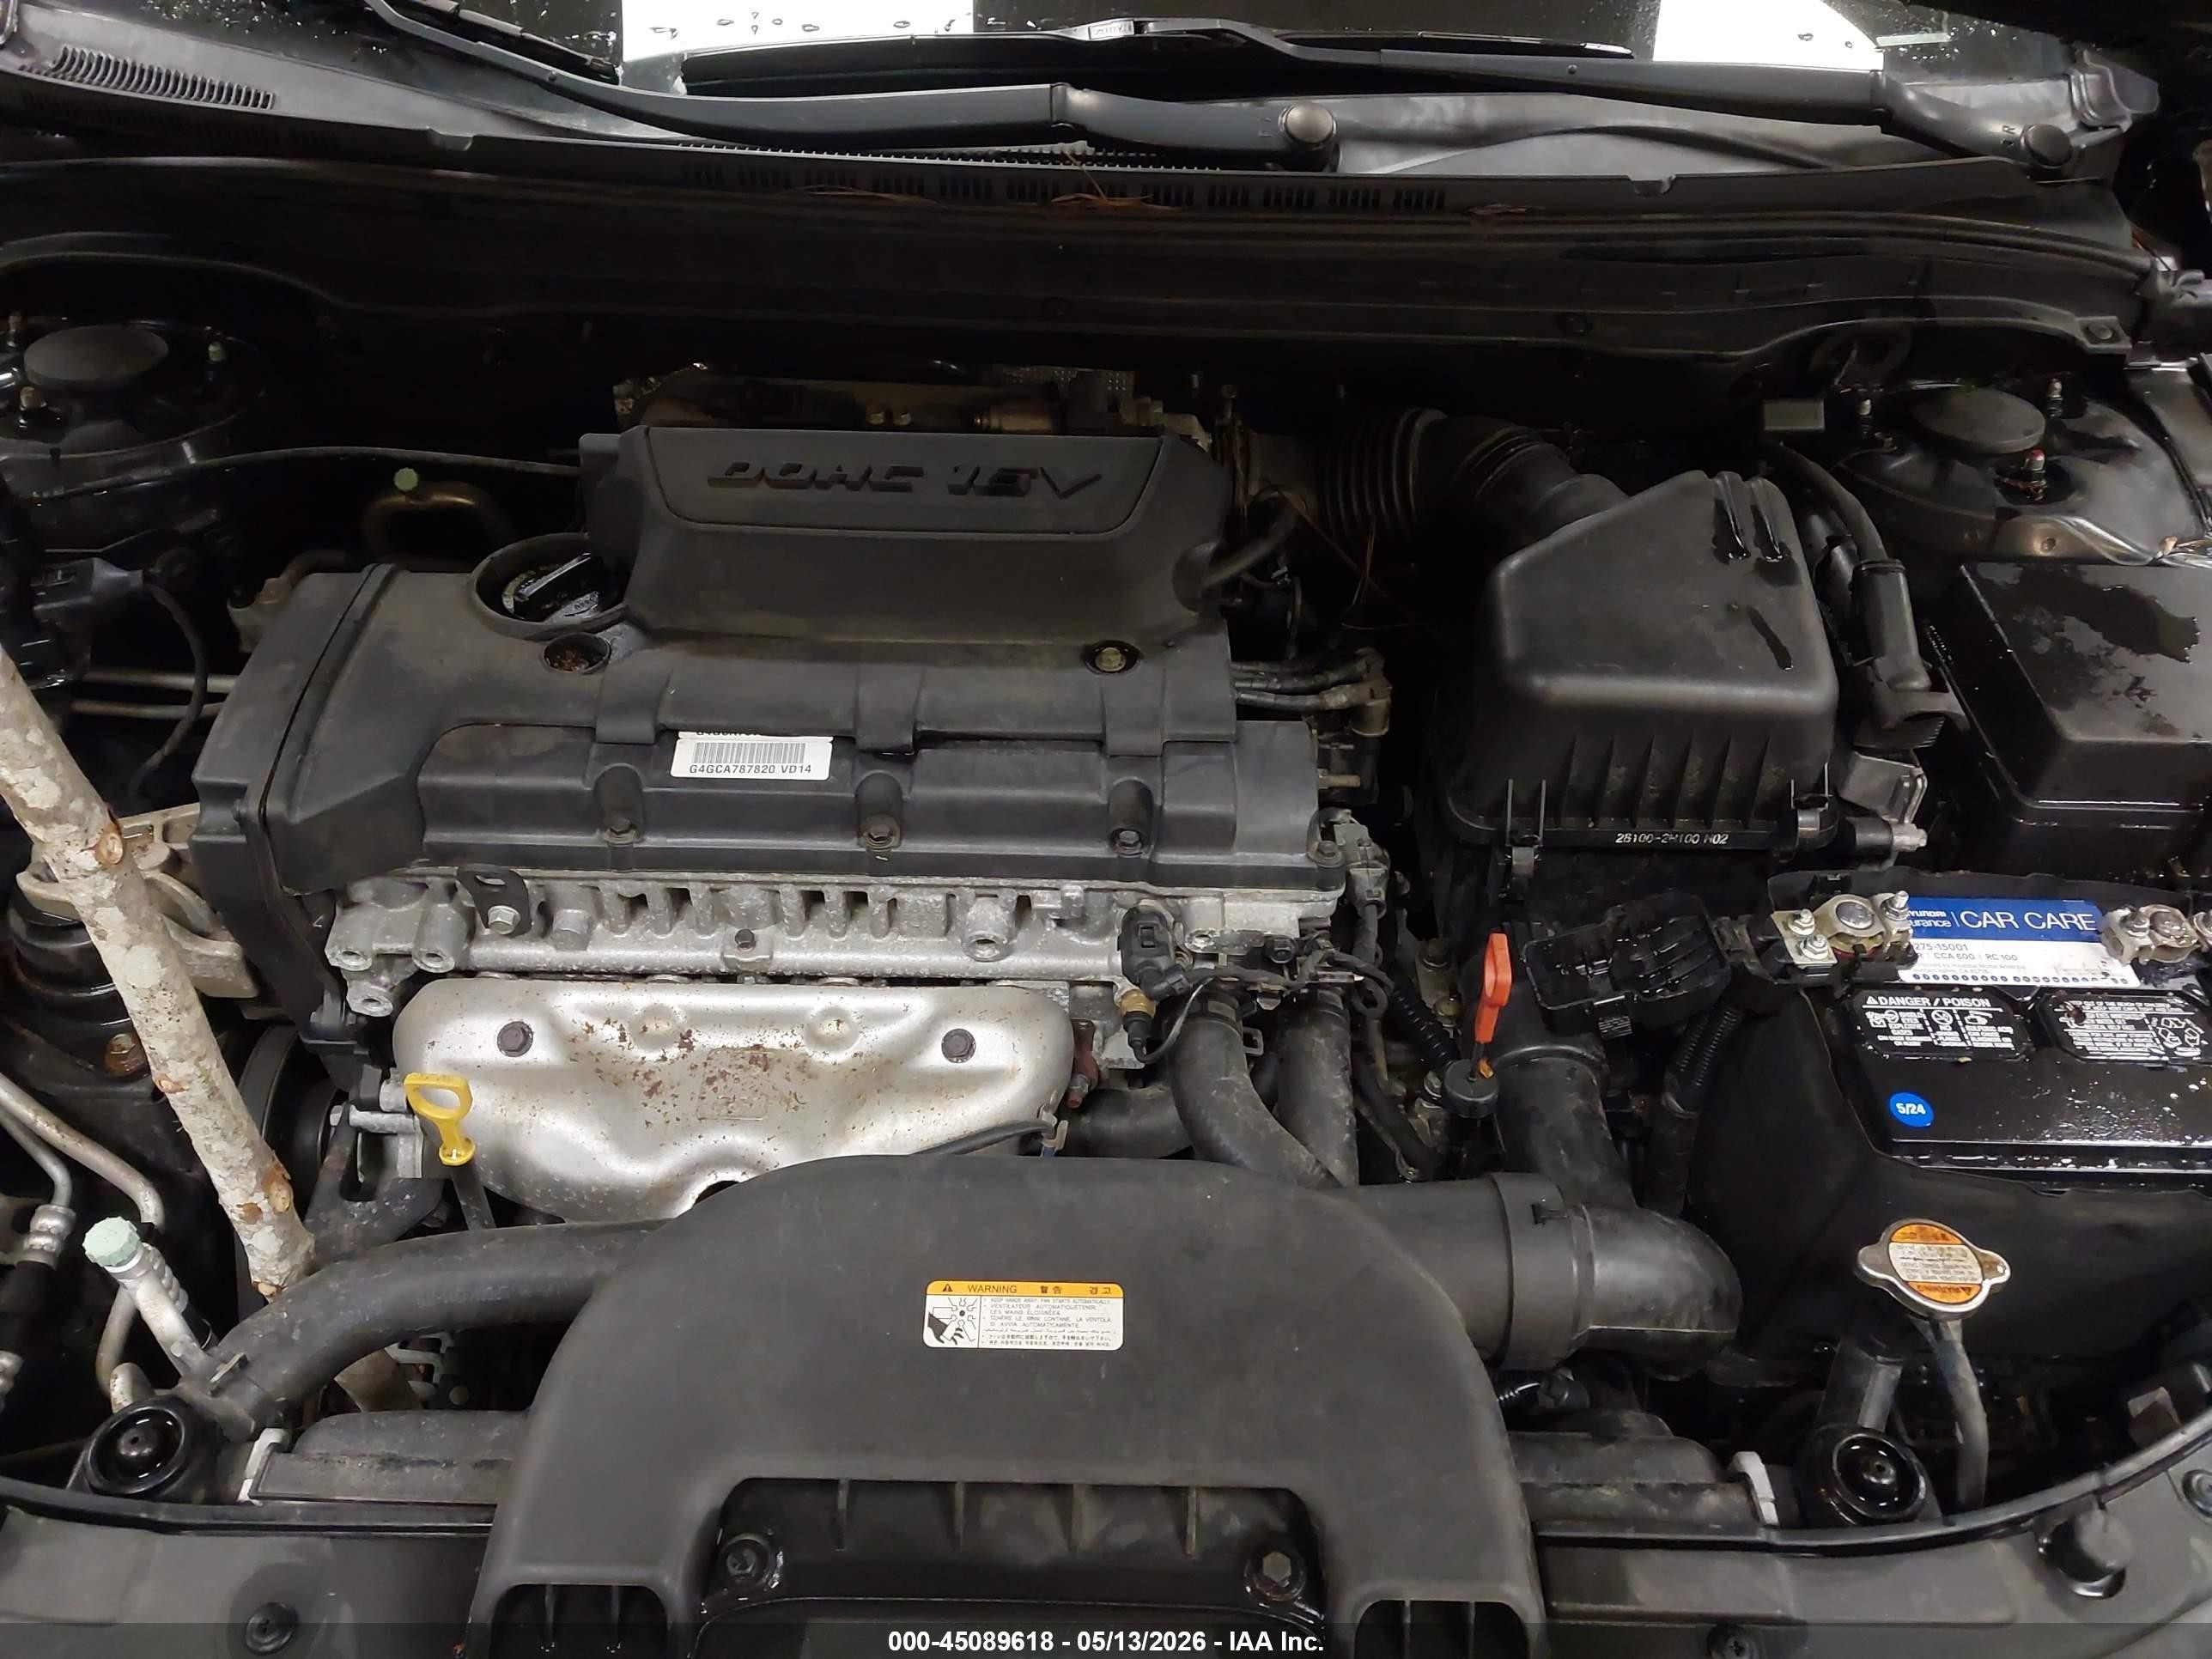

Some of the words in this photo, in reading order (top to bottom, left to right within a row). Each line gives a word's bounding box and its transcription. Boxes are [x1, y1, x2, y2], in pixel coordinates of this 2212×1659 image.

[707, 461, 925, 491] DOHC
[947, 465, 1103, 501] 16V
[689, 764, 775, 774] G4GCA787820
[781, 764, 811, 775] VD14
[1909, 919, 1952, 927] urance
[1960, 910, 2020, 929] CAR
[2023, 911, 2097, 931] CARE
[1877, 996, 1931, 1007] DANGER
[1933, 997, 1941, 1006] /
[1942, 998, 1992, 1008] POISON
[1895, 1102, 1926, 1115] 5/24
[968, 1284, 1018, 1294] WARNING
